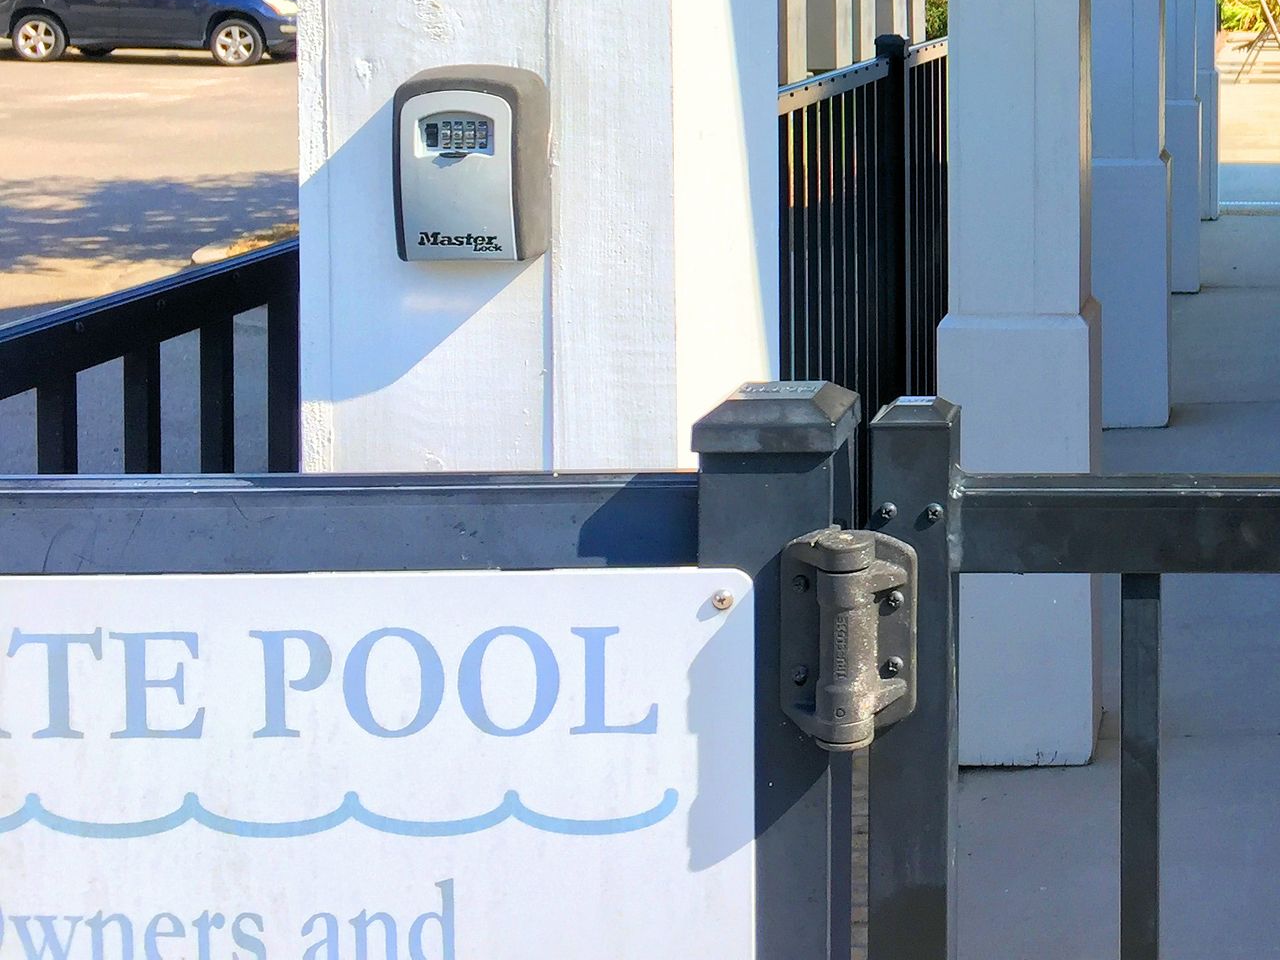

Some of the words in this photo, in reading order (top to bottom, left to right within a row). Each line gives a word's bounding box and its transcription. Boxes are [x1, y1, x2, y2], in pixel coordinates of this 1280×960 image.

[418, 231, 498, 246] Master
[473, 244, 503, 252] Lock
[0, 627, 206, 739] TE
[249, 626, 659, 738] POOL
[0, 906, 267, 960] wners
[301, 878, 456, 960] and
